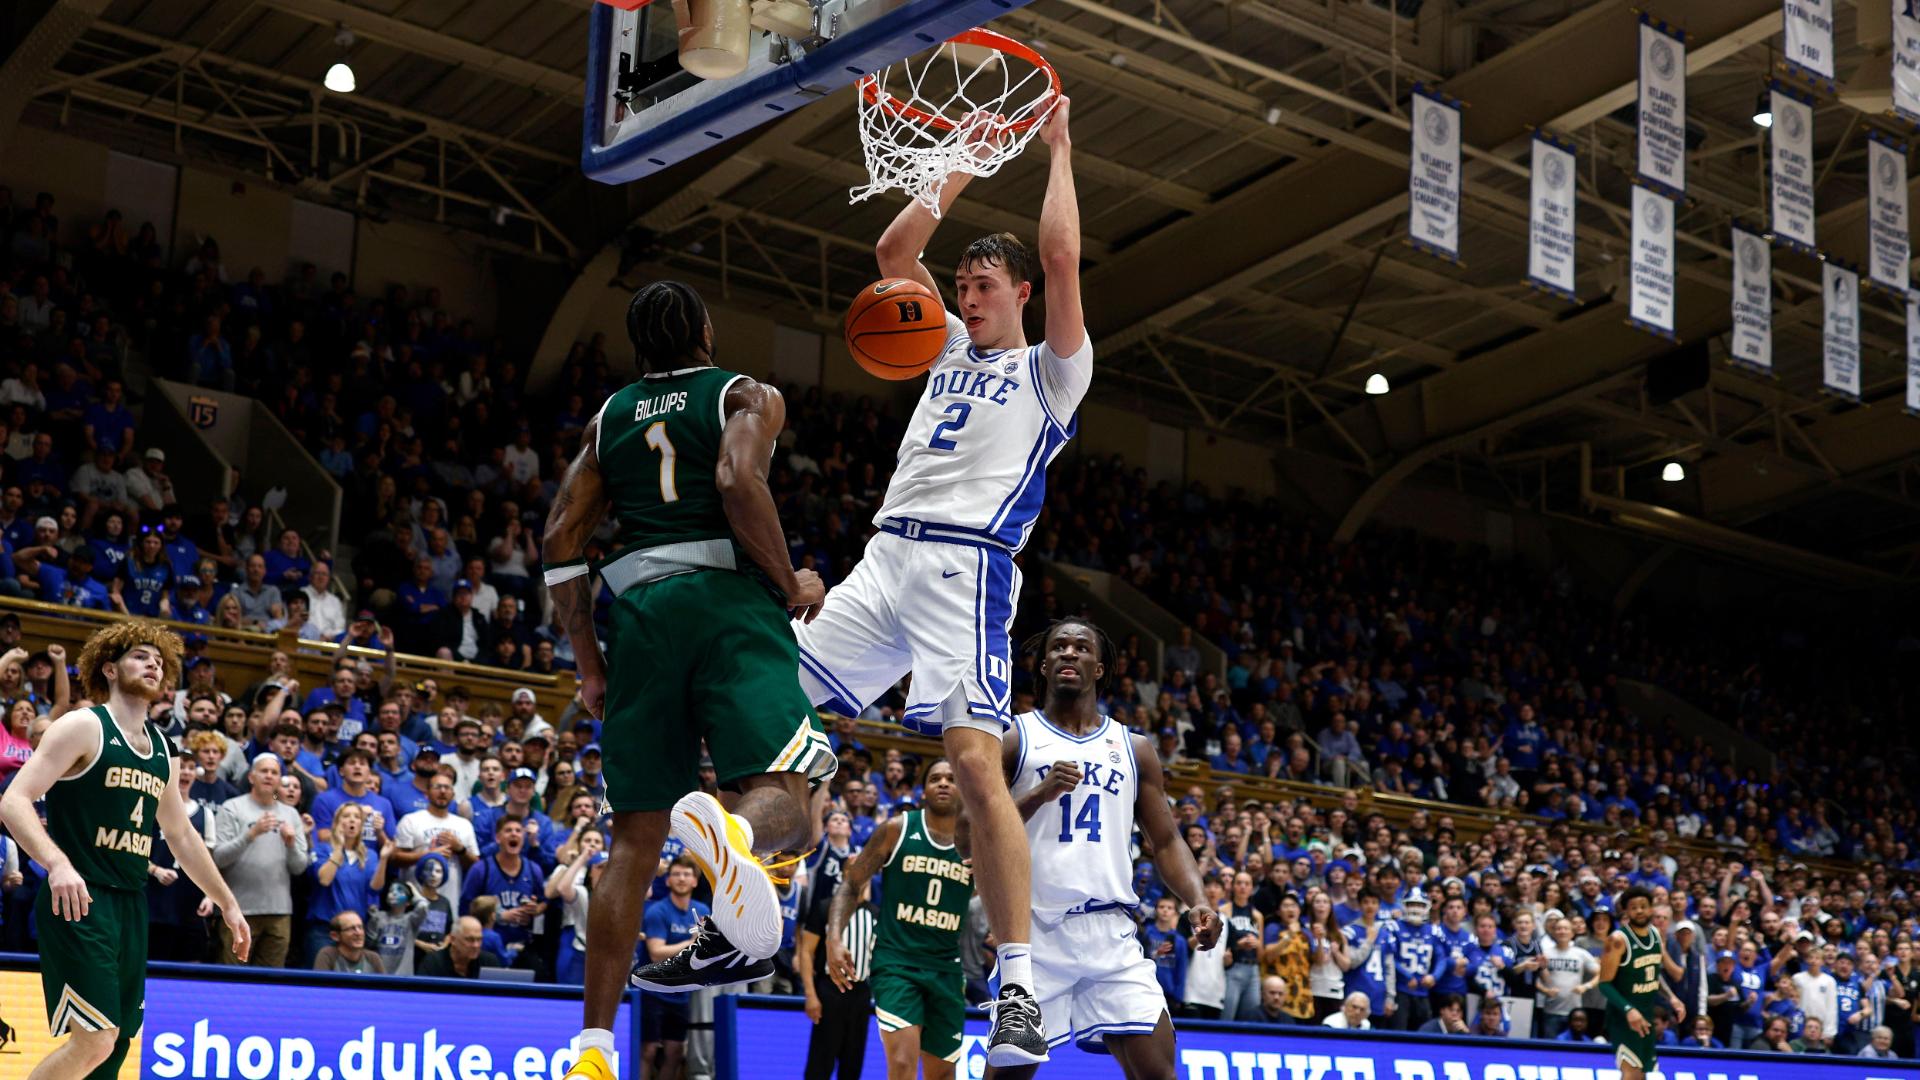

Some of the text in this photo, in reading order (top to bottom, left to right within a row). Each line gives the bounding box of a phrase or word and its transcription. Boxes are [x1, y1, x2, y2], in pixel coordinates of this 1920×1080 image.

[930, 371, 1020, 406] DUKE
[195, 405, 214, 426] 15
[635, 392, 688, 422] BILLUPS
[928, 402, 972, 451] 2
[644, 421, 679, 503] 1
[987, 654, 1007, 683] D
[1036, 760, 1124, 797] DKE
[130, 795, 144, 829] 4
[1058, 793, 1102, 843] 14
[95, 826, 153, 858] MASON
[902, 855, 970, 886] GEORGE
[926, 878, 943, 907] 0
[896, 902, 961, 931] MASON
[1366, 948, 1384, 981] 4
[1400, 942, 1433, 976] 53
[1841, 997, 1852, 1012] 2
[152, 1018, 619, 1080] shop.duke.ed
